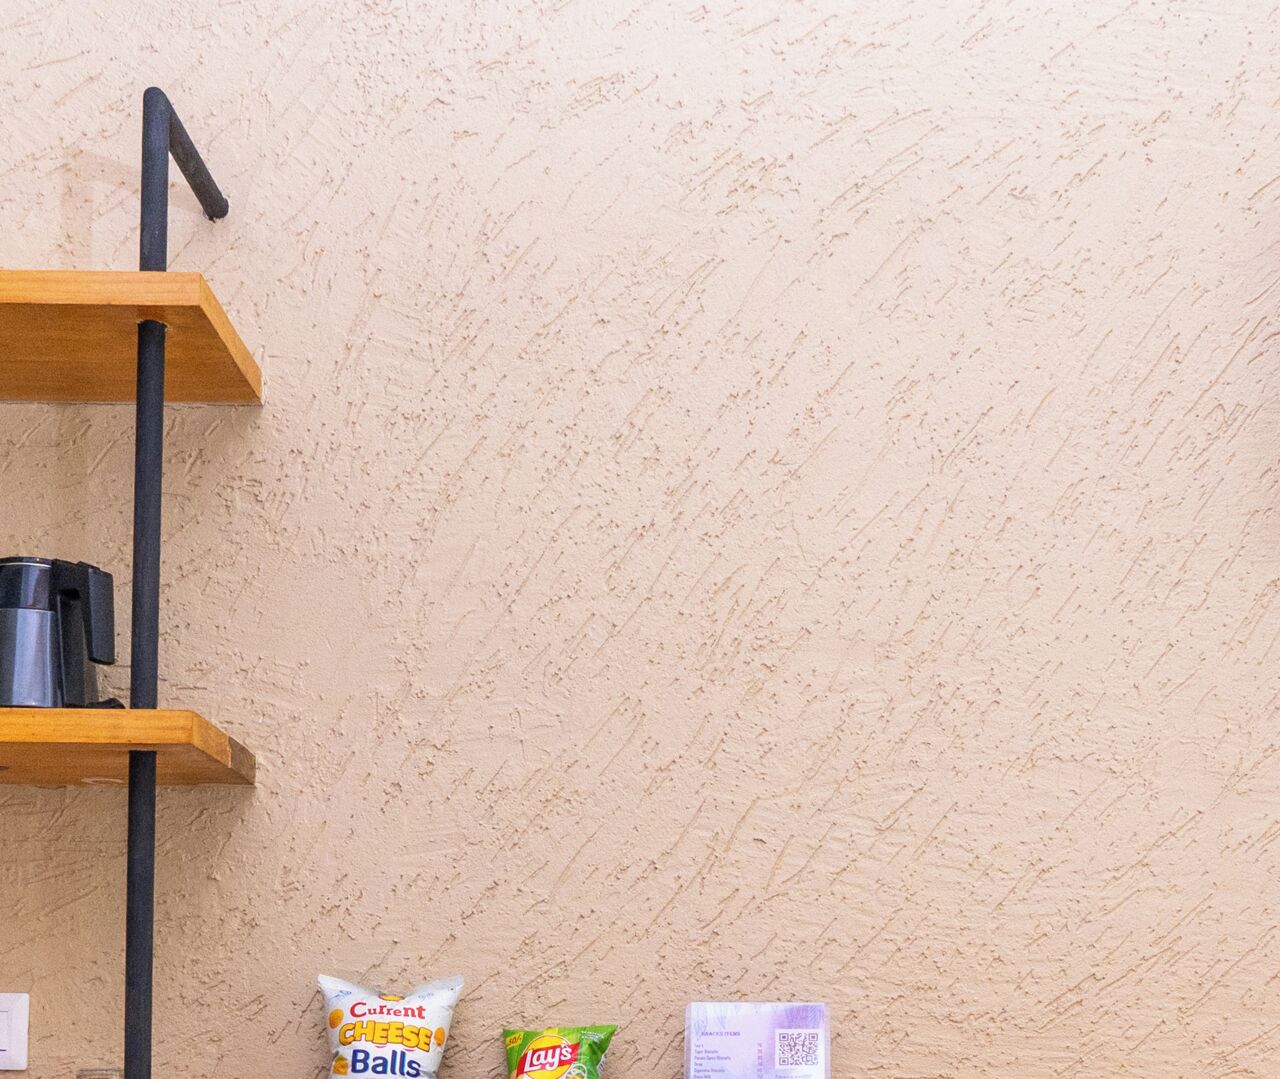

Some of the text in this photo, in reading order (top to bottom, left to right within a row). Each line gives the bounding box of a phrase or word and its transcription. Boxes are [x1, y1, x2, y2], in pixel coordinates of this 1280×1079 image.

[350, 1002, 426, 1019] Current
[339, 1020, 432, 1053] CHEESE
[351, 1049, 421, 1078] Balls
[524, 1041, 573, 1072] Lay's
